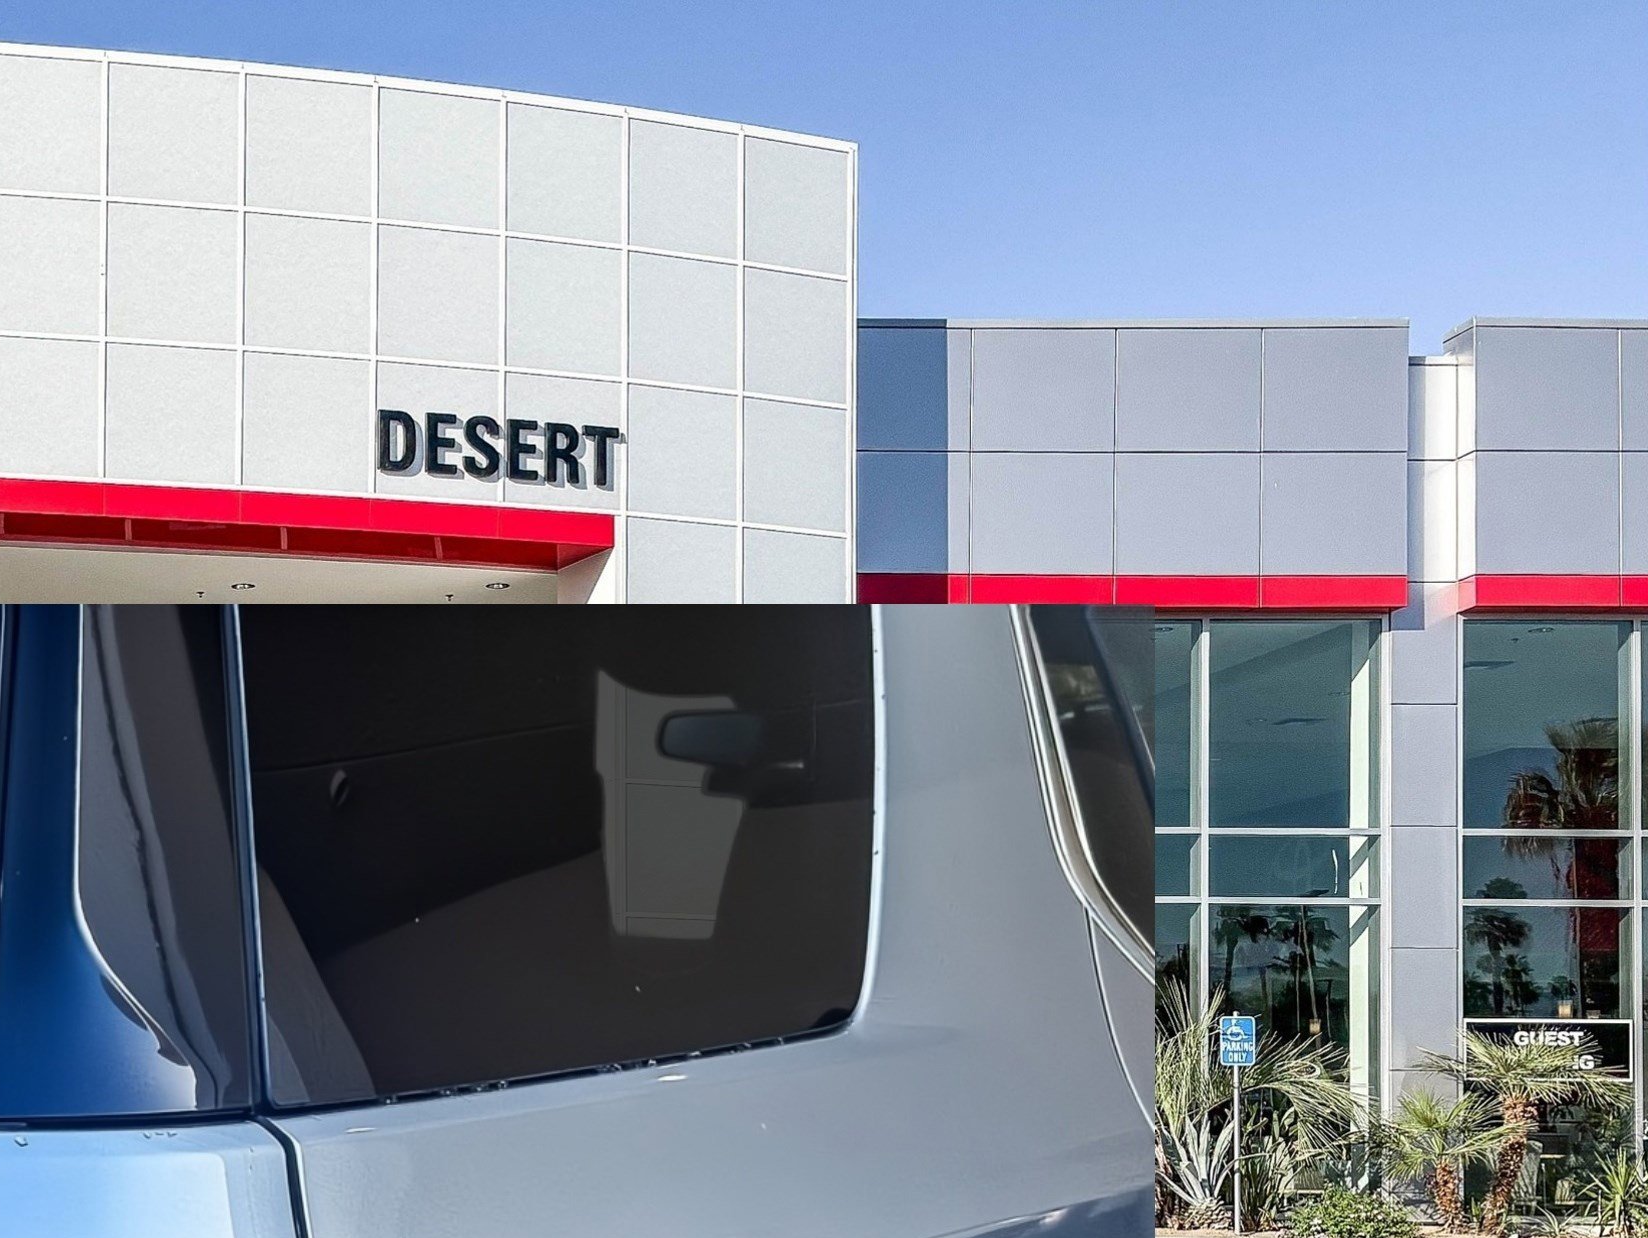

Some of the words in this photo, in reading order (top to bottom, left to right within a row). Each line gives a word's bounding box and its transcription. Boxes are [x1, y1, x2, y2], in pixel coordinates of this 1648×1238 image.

[377, 409, 620, 487] DESERT
[1513, 1031, 1584, 1046] GUEST
[1222, 1041, 1253, 1052] PARKING
[1228, 1051, 1247, 1062] ONLY
